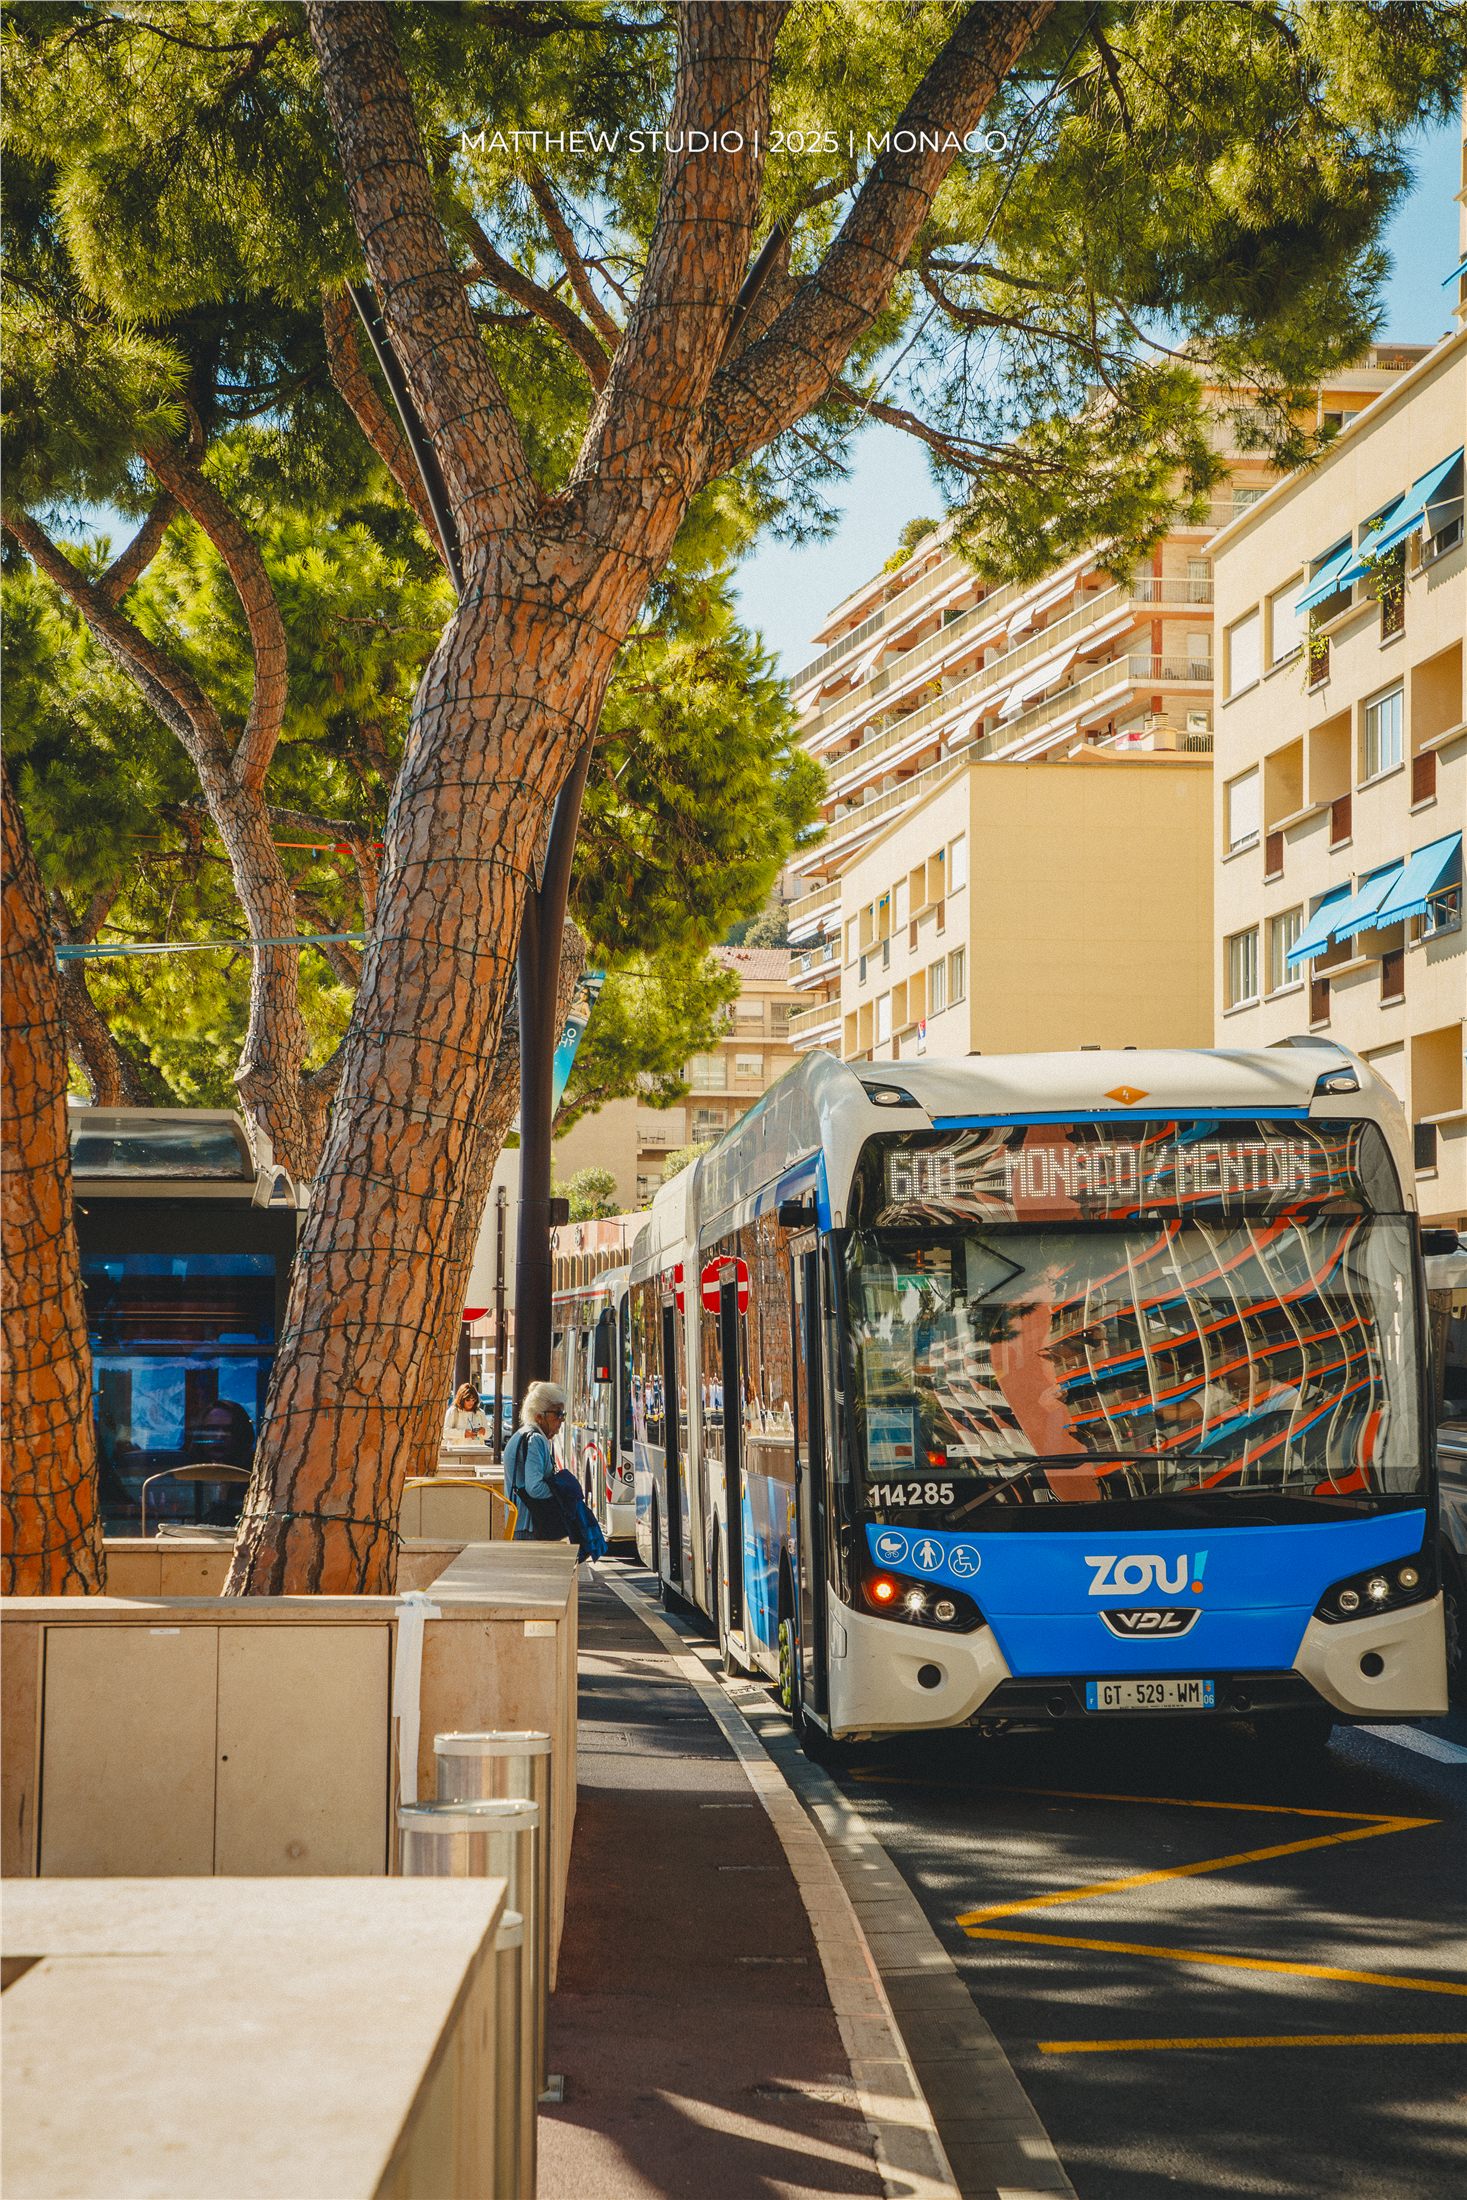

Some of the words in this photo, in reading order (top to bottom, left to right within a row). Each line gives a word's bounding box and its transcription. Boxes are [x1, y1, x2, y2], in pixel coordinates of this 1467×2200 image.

[890, 1151, 956, 1201] 600
[1004, 1145, 1139, 1199] MONACO
[1177, 1140, 1311, 1193] MENTON
[868, 1482, 955, 1507] 114285
[1116, 1612, 1182, 1630] VDL
[1203, 1694, 1215, 1706] 06
